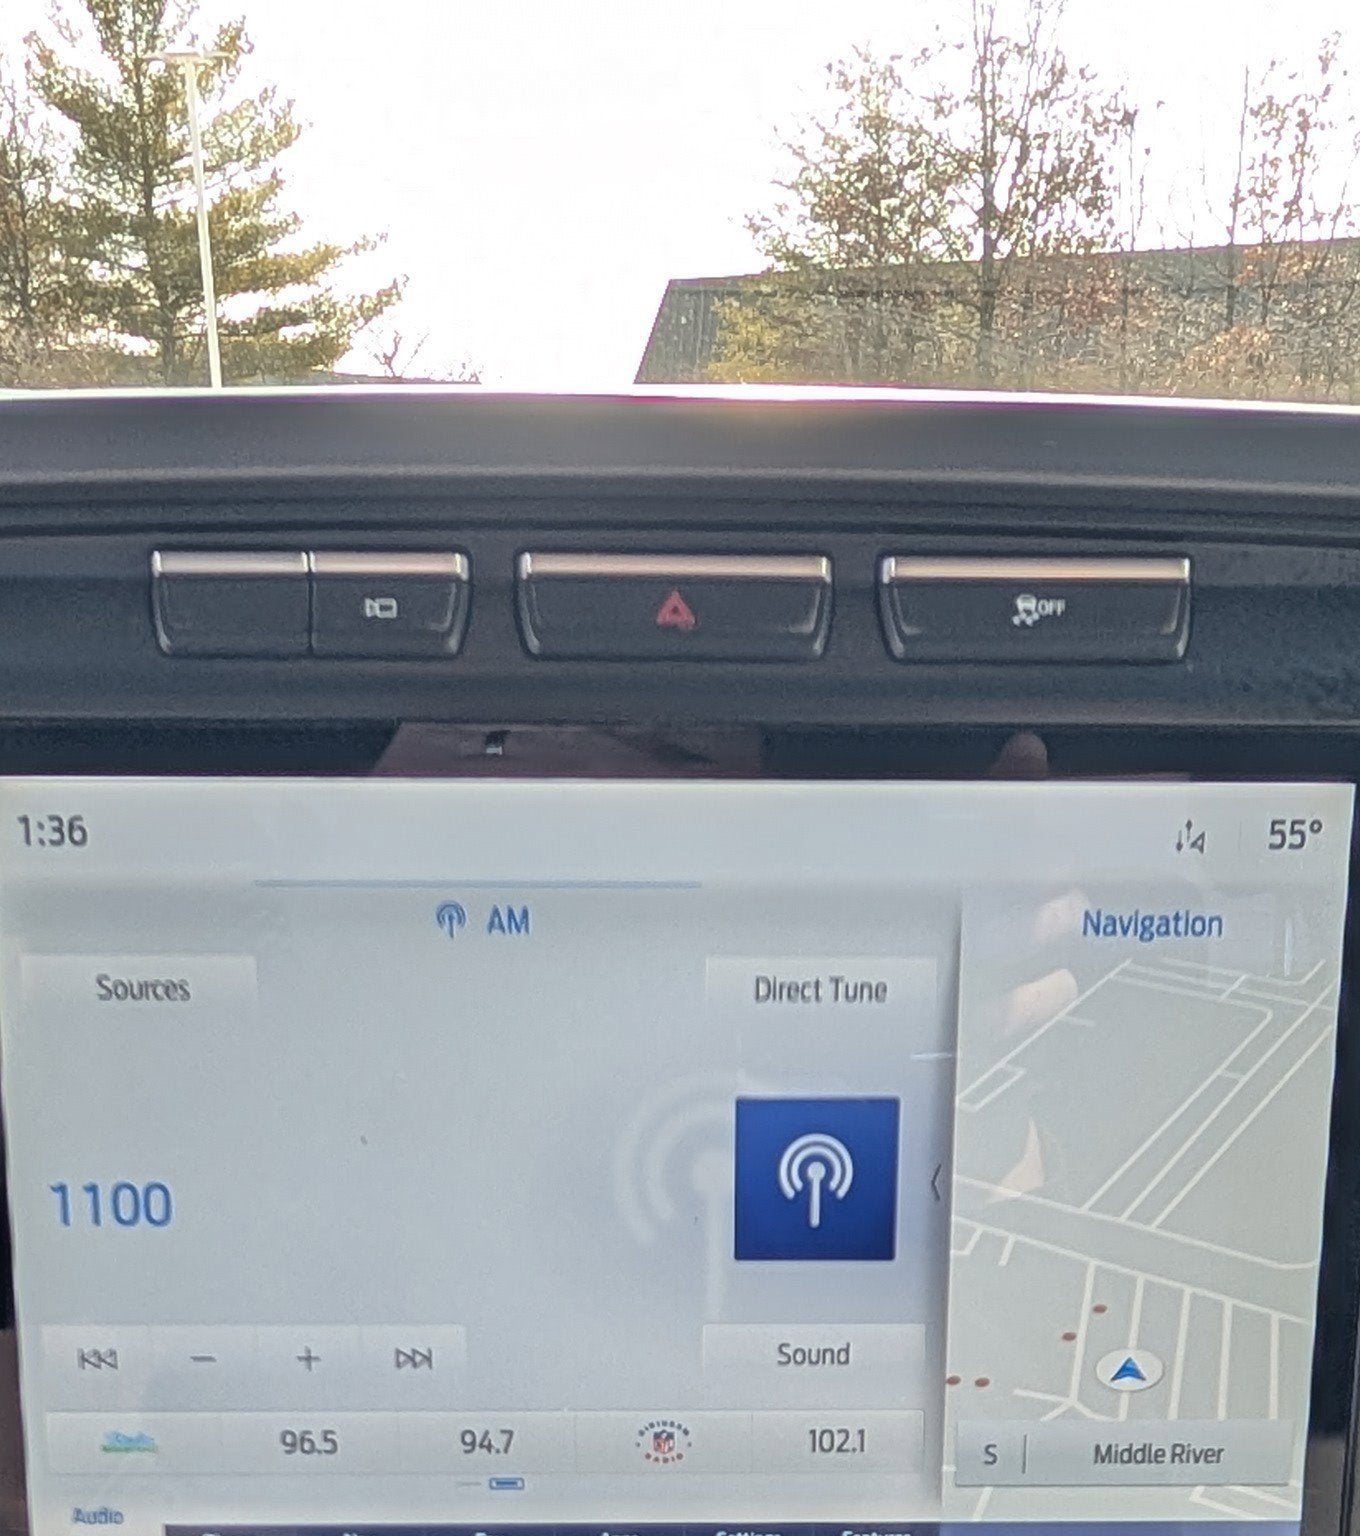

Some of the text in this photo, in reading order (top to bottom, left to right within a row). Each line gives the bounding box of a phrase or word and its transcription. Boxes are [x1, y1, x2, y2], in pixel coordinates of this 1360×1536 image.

[1039, 599, 1066, 616] OFF
[17, 814, 89, 847] 1:36
[486, 906, 531, 936] AM
[1082, 909, 1224, 942] Navigation
[96, 974, 192, 1003] Sources
[754, 975, 888, 1004] Direct Tune
[50, 1180, 174, 1228] 1100
[777, 1342, 851, 1366] Sound
[281, 1429, 339, 1455] 96.5
[460, 1429, 514, 1455] 94.7
[809, 1428, 867, 1454] 102.1
[1093, 1442, 1224, 1465] Middle River
[984, 1444, 998, 1465] S
[72, 1506, 125, 1525] Audio
